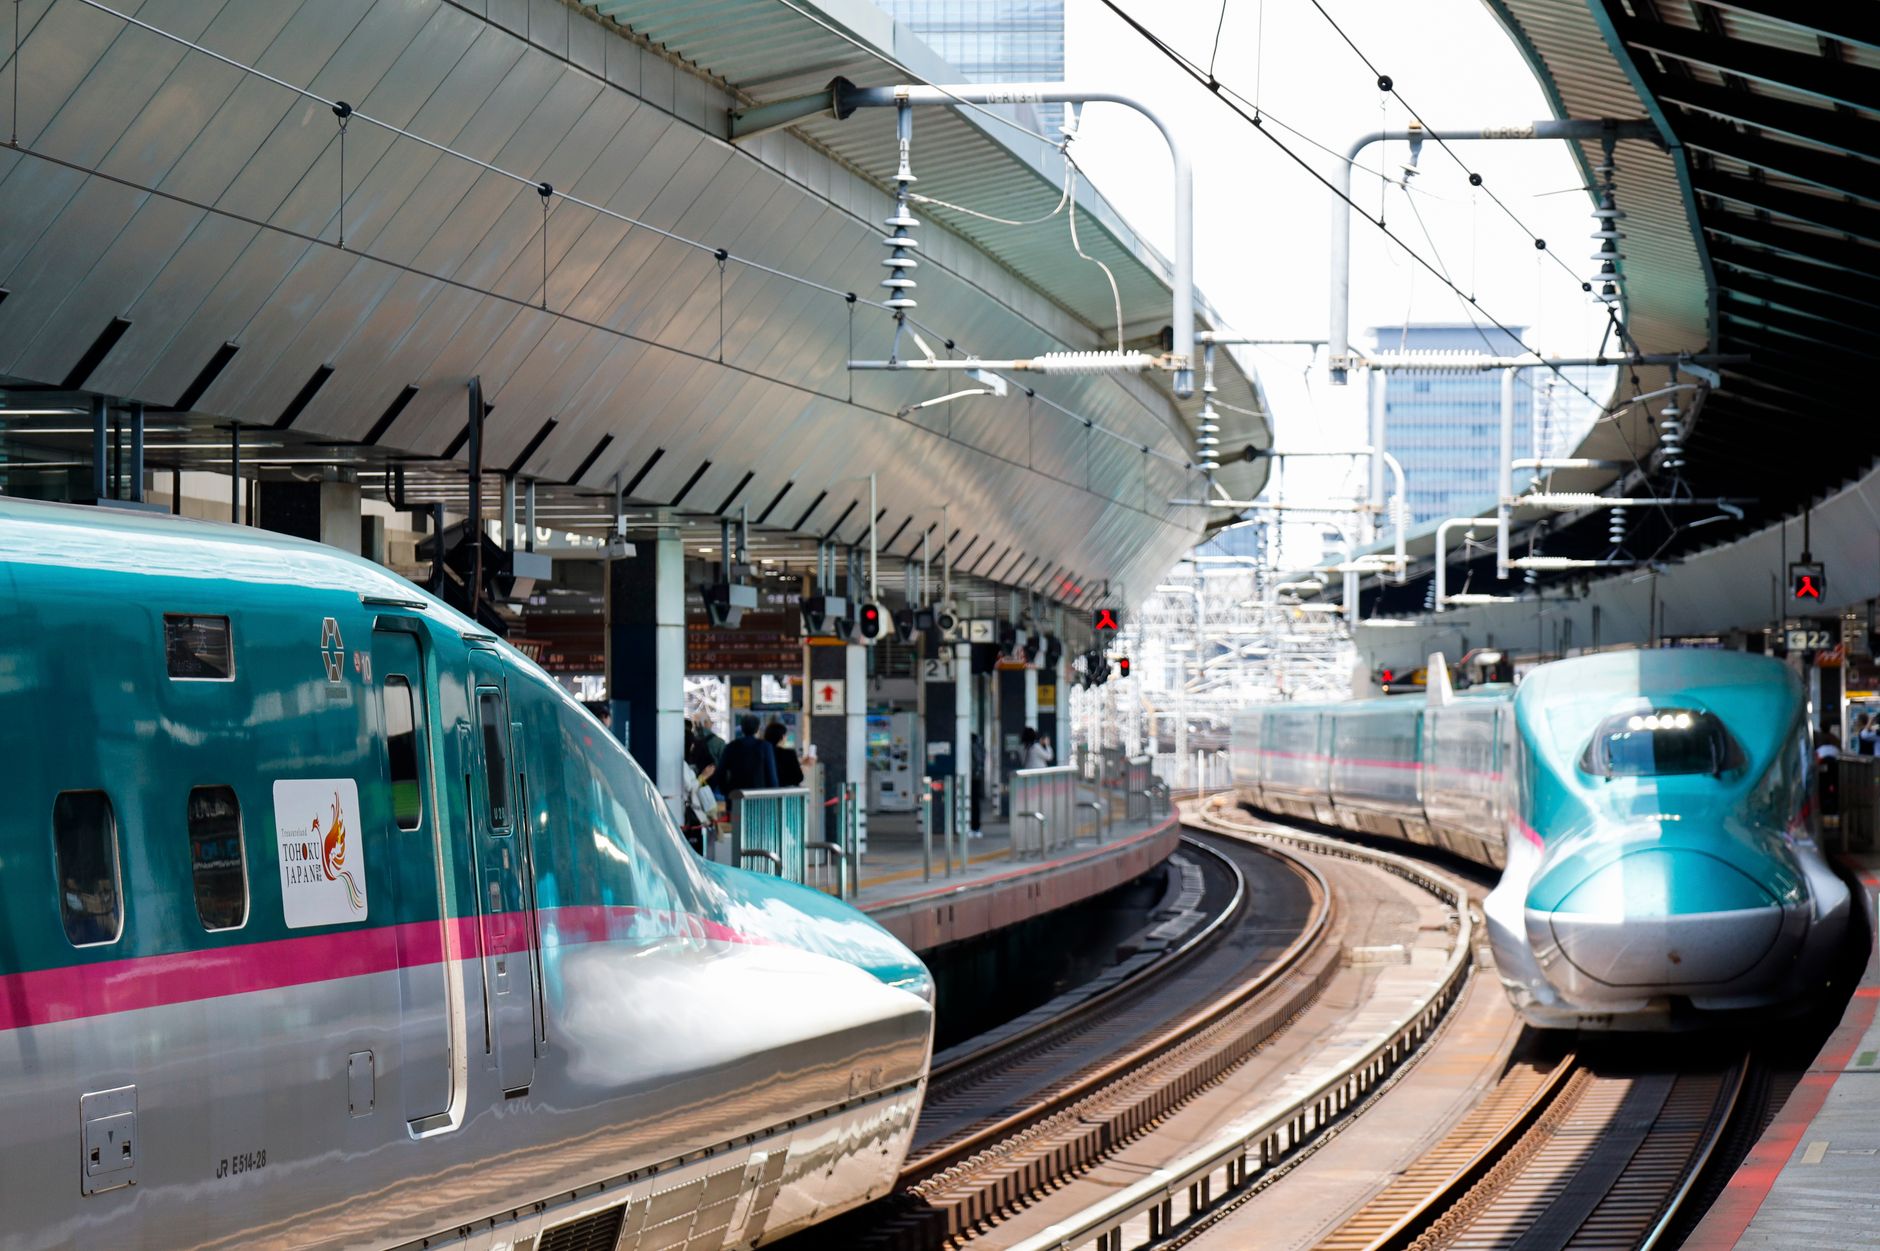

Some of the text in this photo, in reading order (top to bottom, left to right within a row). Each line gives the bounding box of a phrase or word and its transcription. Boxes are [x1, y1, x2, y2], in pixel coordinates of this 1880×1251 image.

[1808, 630, 1830, 649] 22
[361, 655, 372, 681] 10
[926, 660, 950, 680] 21
[282, 842, 320, 862] TOHOKU
[286, 864, 316, 888] JAPAN
[216, 1149, 266, 1179] JR E514-28
